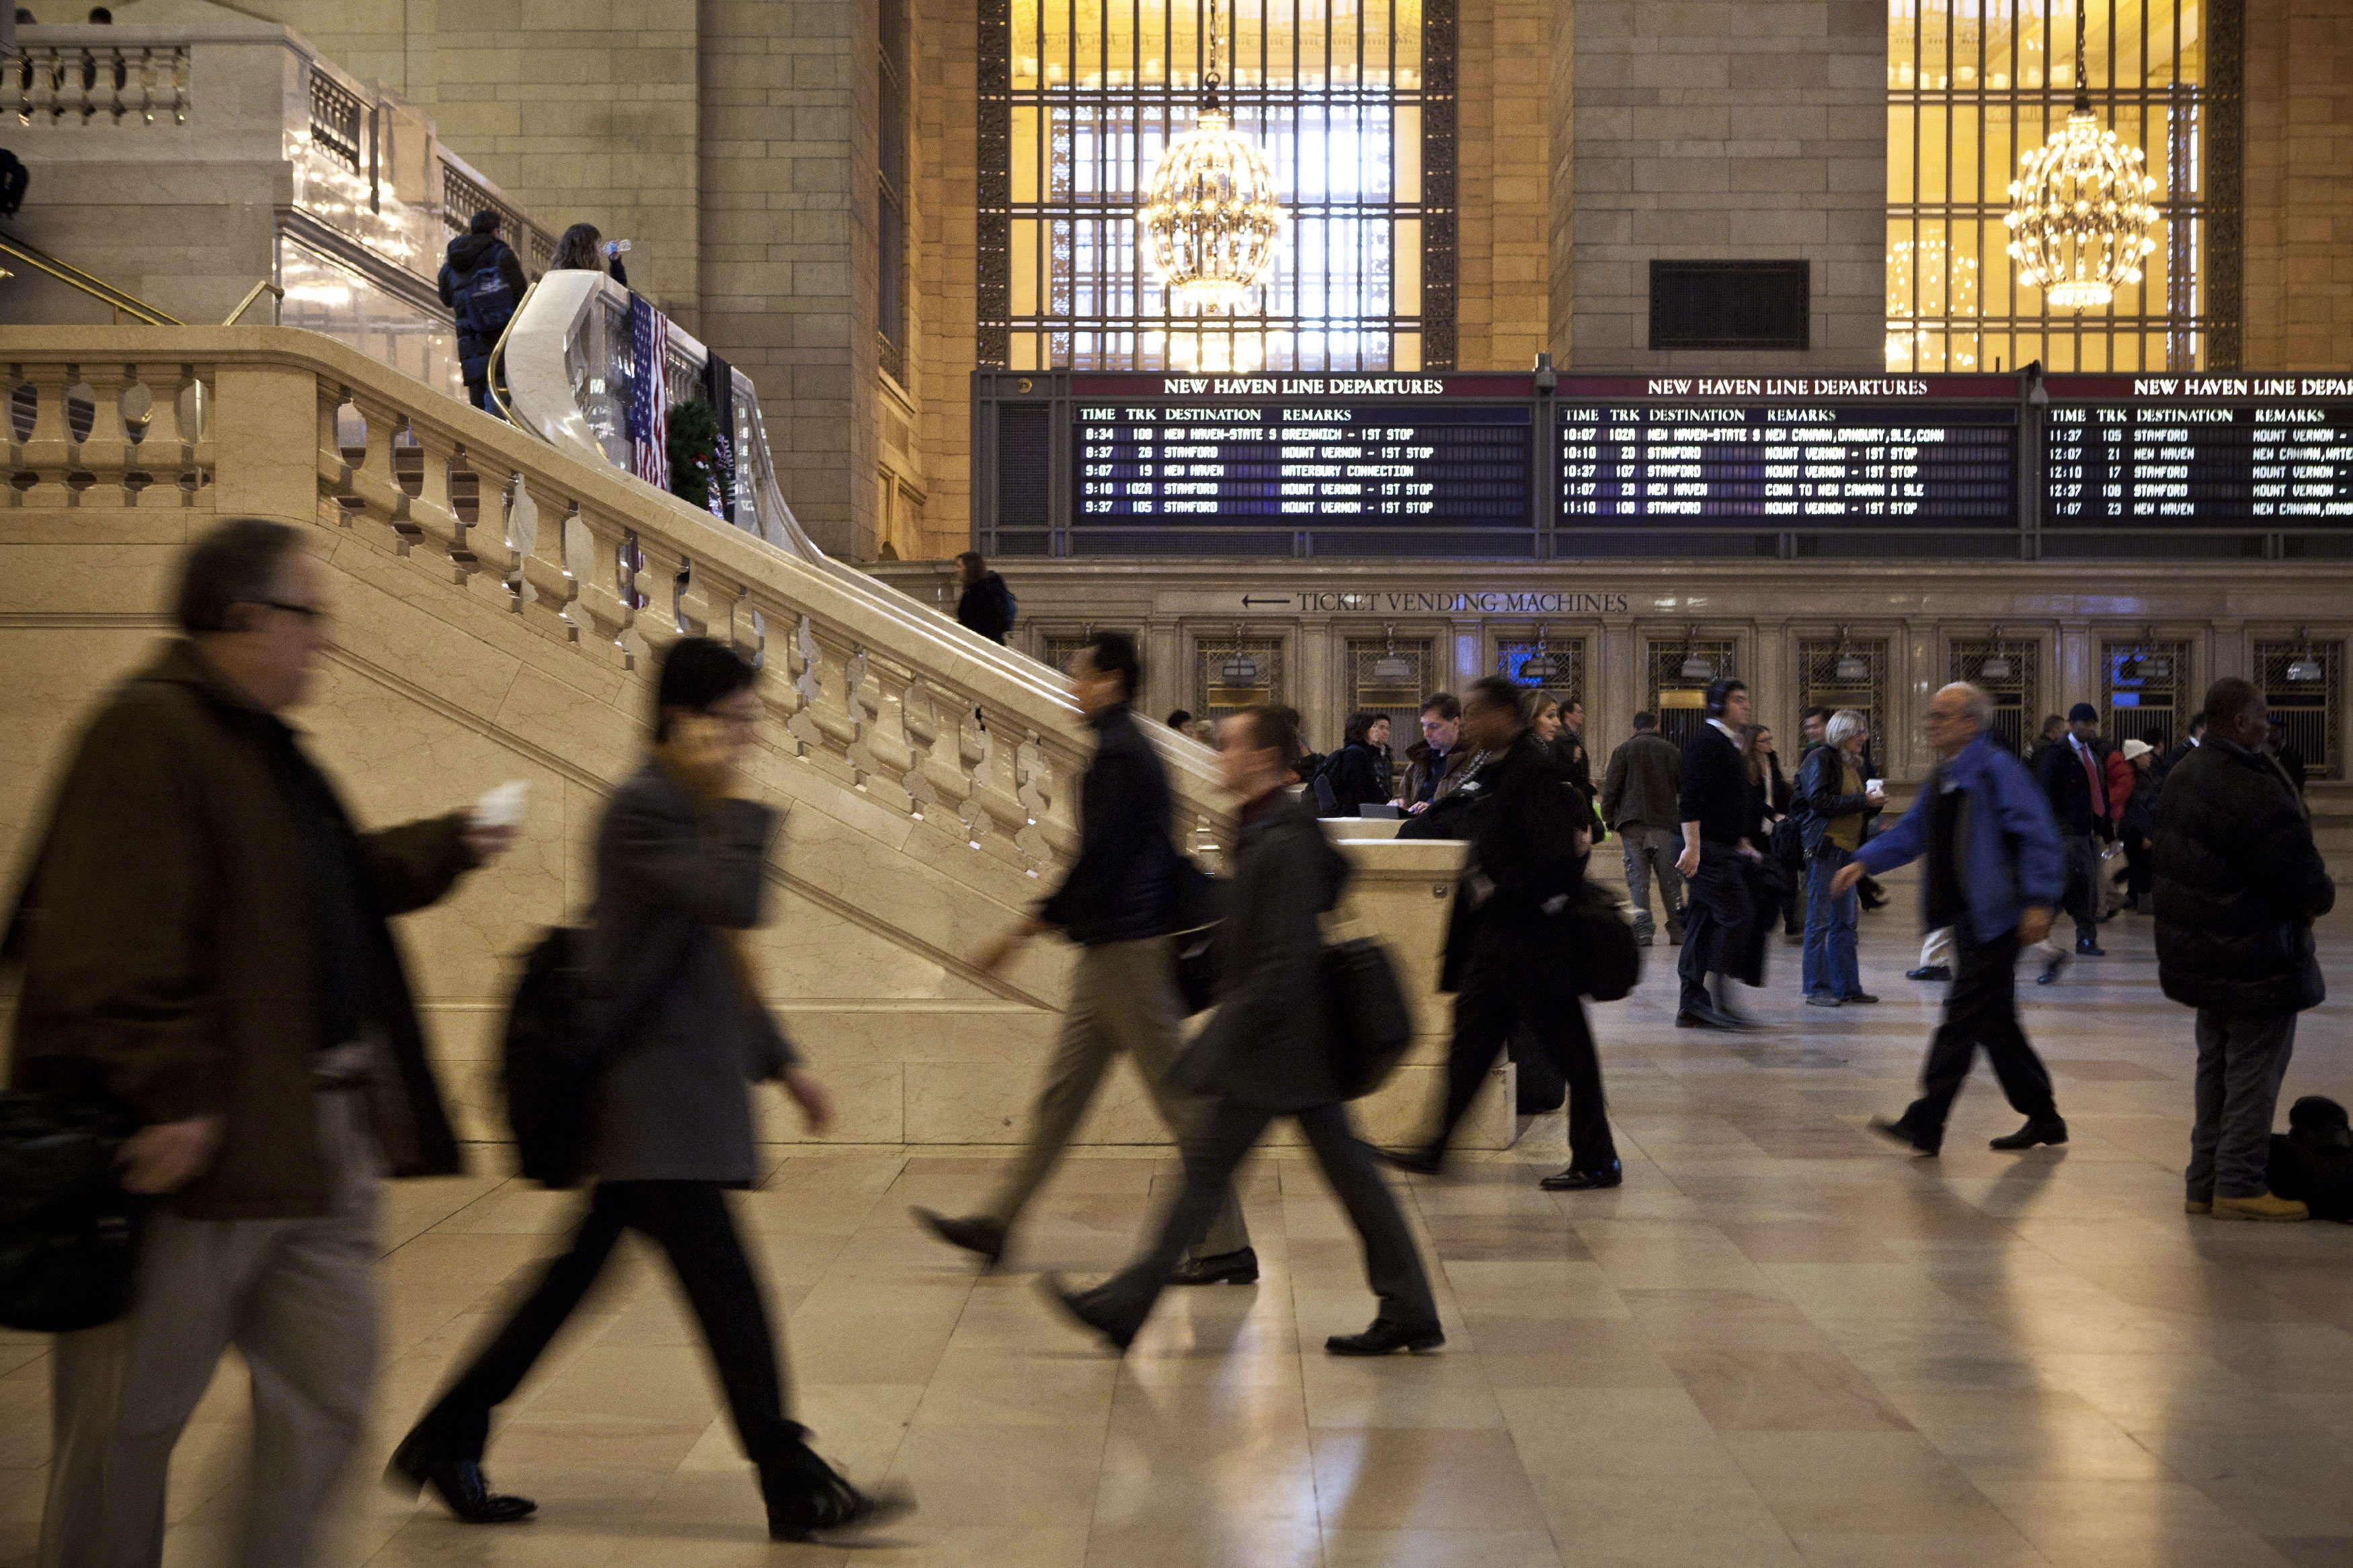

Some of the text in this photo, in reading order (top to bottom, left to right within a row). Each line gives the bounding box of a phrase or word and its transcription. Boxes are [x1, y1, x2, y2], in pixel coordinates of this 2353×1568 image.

[1164, 378, 1443, 395] NEW HAVEN LINE DEPARTURES
[1648, 378, 1927, 395] NEW HAVEN LINE DEPARTURES
[2134, 379, 2179, 396] NEW
[2184, 378, 2247, 396] HAVEN
[2254, 379, 2297, 396] LINE
[1080, 408, 1352, 421] TIME TRK DESTINATION REMARKS
[1564, 409, 1836, 422] TIME TRK DESTINATION REMARKS
[2050, 408, 2325, 423] TIME TRK DESTINATION REMARKS
[1086, 427, 1114, 440] 8:34
[1164, 428, 1185, 440] NEW
[1190, 427, 1263, 440] HAVEN-STATE
[1269, 428, 1277, 440] S
[1281, 427, 1342, 441] GREENWICH
[1361, 428, 1381, 440] 1ST
[1386, 428, 1414, 441] STOP
[1564, 428, 1597, 441] 10:07
[1609, 428, 1636, 441] 102A
[1647, 428, 1668, 442] NEW
[1673, 428, 1747, 442] HAVEN-STATE
[1752, 428, 1761, 442] S
[1765, 428, 1787, 442] NEW
[2050, 429, 2082, 442] 11:37
[2102, 429, 2122, 442] 105
[2134, 429, 2188, 442] STAMFORD
[2253, 429, 2286, 442] MOUNT
[2292, 428, 2334, 442] VERNON
[1086, 446, 1113, 458] 8:37
[1164, 446, 1218, 458] STAMFORD
[1281, 446, 1316, 459] MOUNT
[1321, 446, 1362, 458] VERNON
[1381, 447, 1401, 459] 1ST
[1406, 447, 1434, 459] STOP
[1564, 446, 1597, 459] 10:10
[1621, 446, 1636, 460] 20
[1647, 446, 1702, 460] STAMFORD
[1765, 446, 1800, 460] MOUNT
[1804, 446, 1846, 460] VERNON
[1865, 447, 1885, 460] 1ST
[1890, 447, 1918, 460] STOP
[2050, 448, 2082, 460] 12:07
[2108, 448, 2120, 460] 21
[2134, 448, 2155, 460] NEW
[2160, 446, 2195, 460] HAVEN
[2253, 447, 2274, 460] NEW
[1086, 464, 1414, 477] 9:07 19 NEW HAVEN WATERBURY CONNECTION
[1564, 464, 1596, 478] 10:37
[1616, 464, 1636, 478] 107
[1647, 464, 1702, 478] STAMFORD
[1765, 464, 1799, 479] MOUNT
[1804, 465, 1845, 479] VERNON
[1865, 465, 1885, 479] 1ST
[1890, 465, 1918, 479] STOP
[2050, 465, 2082, 479] 12:10
[2108, 465, 2122, 479] 17
[2134, 465, 2188, 479] STAMFORD
[2252, 466, 2286, 479] MOUNT
[2292, 465, 2334, 479] VERNON
[1085, 482, 1113, 495] 9:10
[1125, 482, 1152, 495] 102A
[1164, 483, 1218, 495] STAMFORD
[1281, 483, 1315, 495] MOUNT
[1320, 483, 1361, 495] VERNON
[1381, 483, 1400, 495] 1ST
[1406, 483, 1433, 495] STOP
[1564, 483, 1596, 496] 11:07
[1647, 483, 1668, 496] NEW
[1673, 483, 1708, 496] HAVEN
[1765, 483, 1793, 497] CONN
[1798, 483, 1812, 497] TO
[1817, 483, 1839, 497] NEW
[1844, 483, 1885, 497] CANAAN
[1890, 483, 1898, 497] &
[1903, 483, 1924, 497] SLE
[2050, 483, 2082, 497] 12:37
[2133, 483, 2188, 497] STAMFORD
[2252, 484, 2286, 497] MOUNT
[2292, 484, 2334, 497] VERNON
[1085, 501, 1113, 513] 9:37
[1133, 501, 1152, 513] 105
[1164, 501, 1218, 513] STAMFORD
[1281, 501, 1316, 513] MOUNT
[1320, 501, 1361, 513] VERNON
[1381, 501, 1400, 513] 1ST
[1406, 501, 1433, 513] STOP
[1564, 501, 1596, 514] 11:10
[1646, 501, 1702, 514] STAMFORD
[1765, 501, 1799, 515] MOUNT
[1804, 501, 1845, 515] VERNON
[1865, 501, 1884, 515] 1ST
[1890, 502, 1917, 515] STOP
[2056, 502, 2082, 515] 1:07
[2108, 502, 2122, 515] 23
[2134, 502, 2155, 515] NEW
[2160, 502, 2194, 515] HAVEN
[2253, 502, 2274, 515] NEW
[1297, 593, 1628, 612] TICKET VENDING MACHINES
